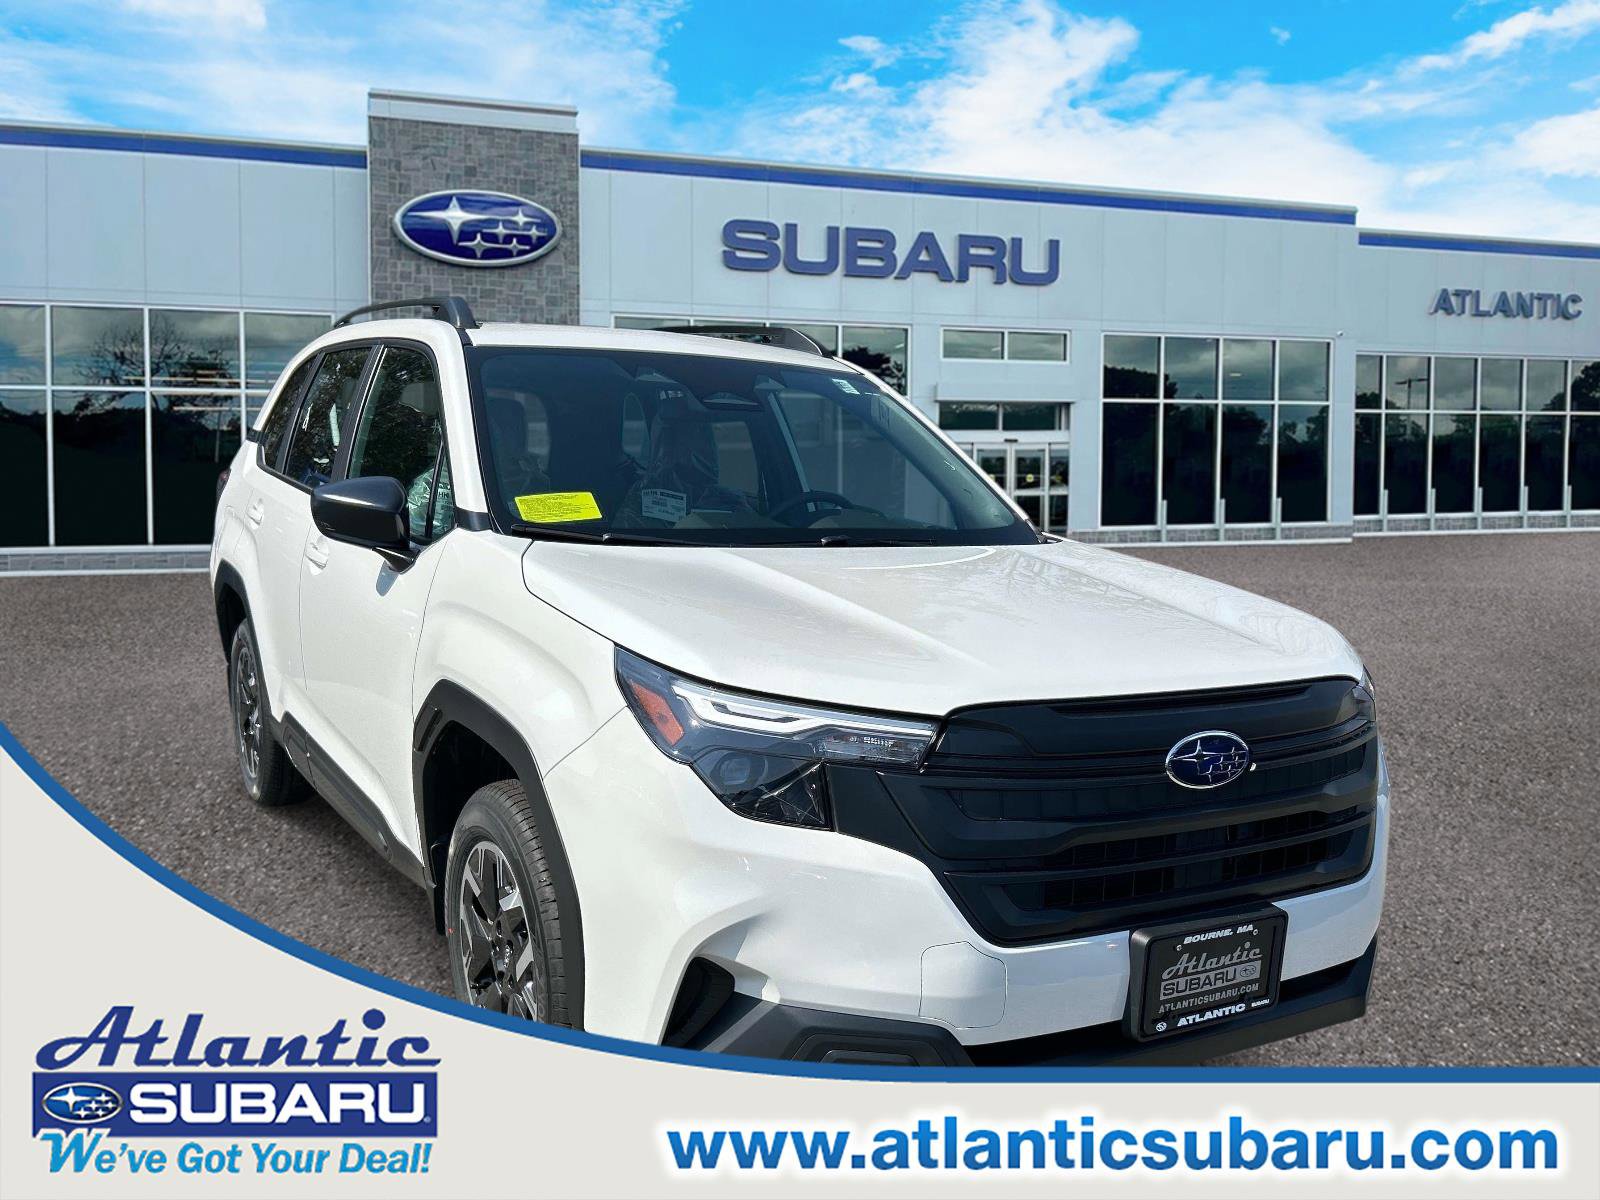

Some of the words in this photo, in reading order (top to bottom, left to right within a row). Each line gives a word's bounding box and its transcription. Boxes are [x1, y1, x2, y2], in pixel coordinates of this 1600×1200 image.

[722, 219, 1060, 286] SUBARU
[1429, 288, 1583, 320] ATLANTIC
[1236, 924, 1254, 934] MA
[1161, 941, 1263, 980] Atlantic
[1162, 967, 1237, 997] SUBARU
[1158, 983, 1260, 1014] ATLANTICSUBARU.COM
[1177, 1003, 1246, 1027] ATLANTIC
